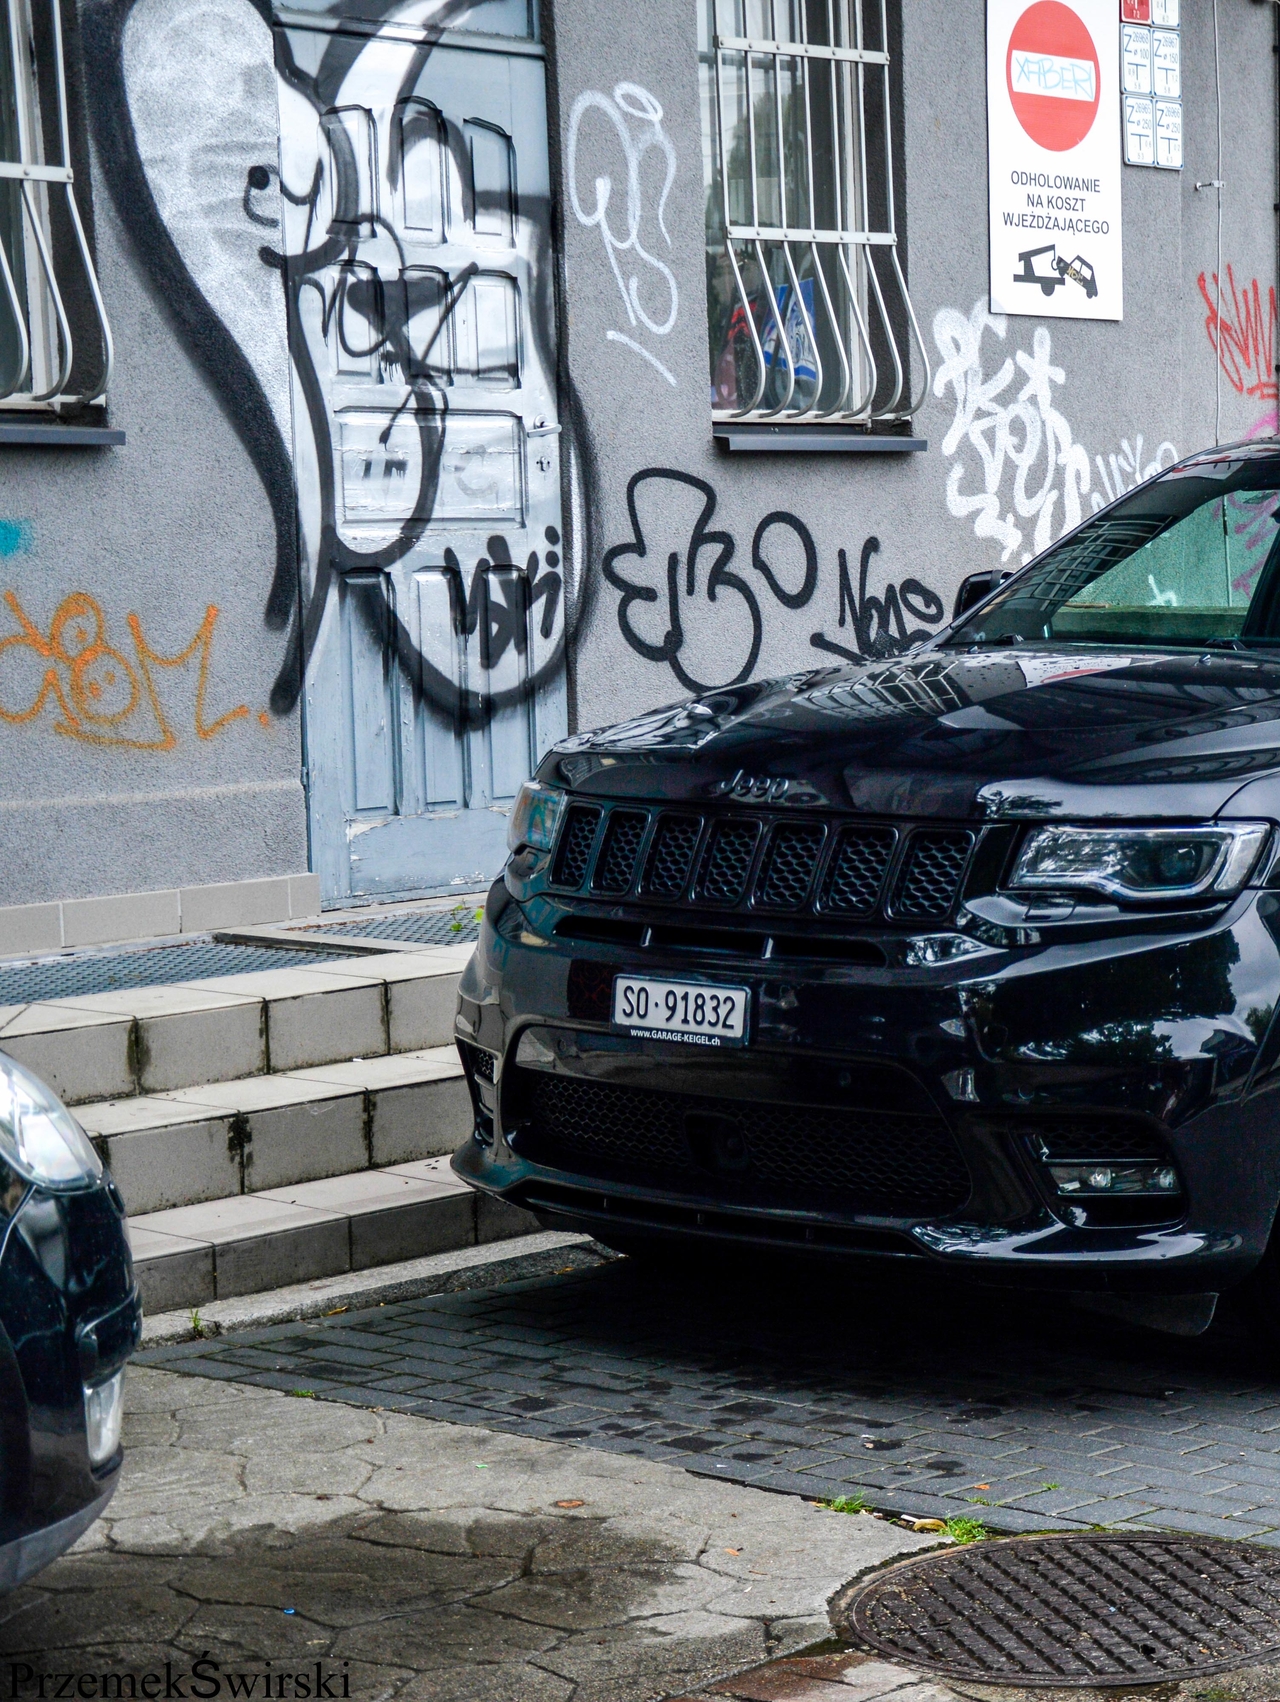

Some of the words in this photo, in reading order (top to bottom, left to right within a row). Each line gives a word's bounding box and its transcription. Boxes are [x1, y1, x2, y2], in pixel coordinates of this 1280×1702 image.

[1011, 170, 1101, 193] ODHOLOWANIE
[1026, 193, 1044, 209] NA
[1046, 195, 1086, 212] KOSZT
[1002, 211, 1110, 236] WJEŻDŻAJĄCEGO
[717, 769, 789, 803] Jeep
[630, 1028, 721, 1046] www.GARAGE-KEIGEL.ch
